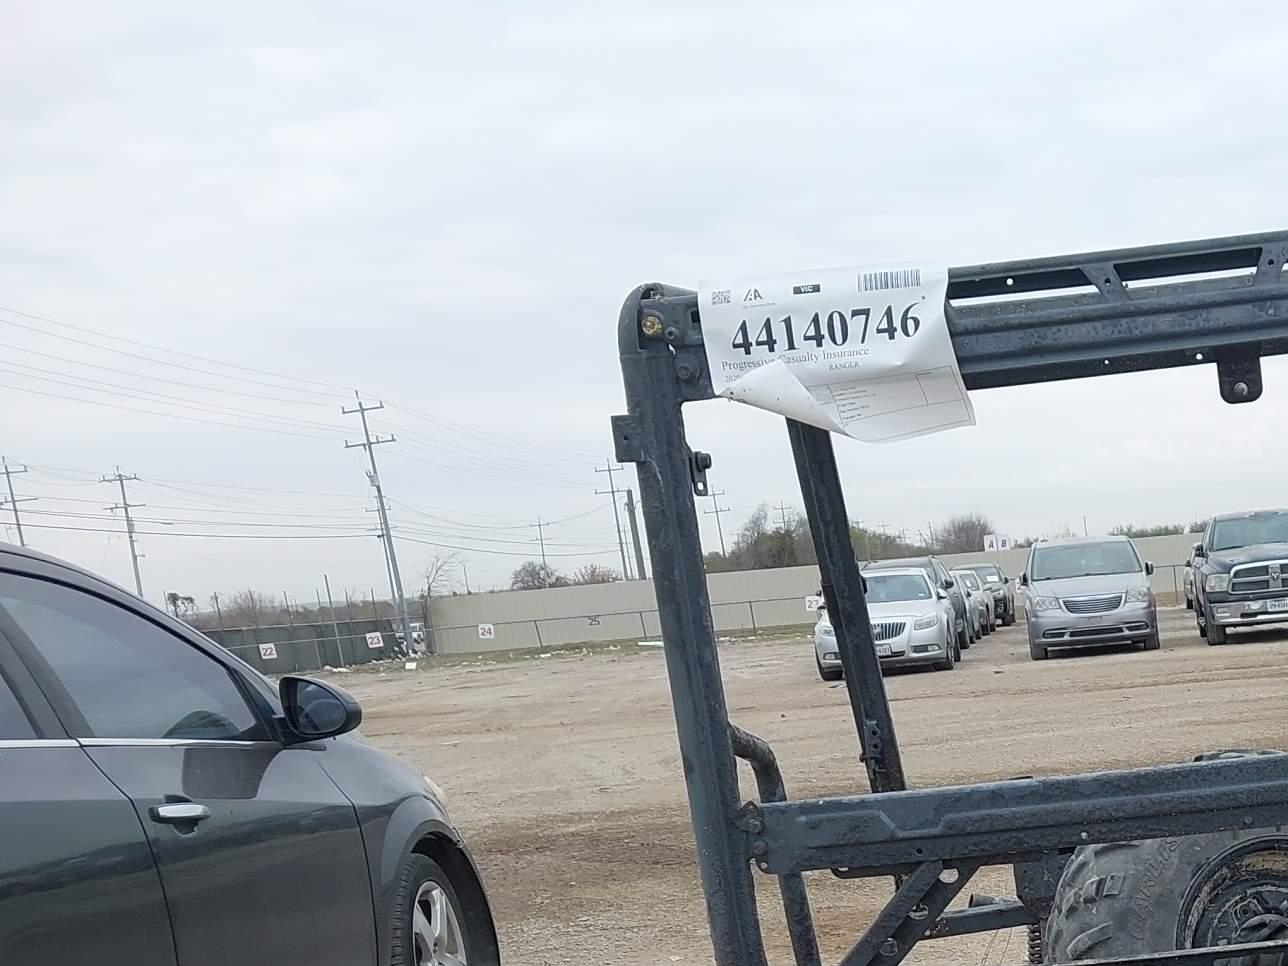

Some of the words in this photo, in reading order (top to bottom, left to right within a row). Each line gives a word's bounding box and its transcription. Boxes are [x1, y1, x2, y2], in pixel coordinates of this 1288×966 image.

[731, 301, 921, 356] 44140746
[823, 347, 869, 360] Insurance
[828, 361, 860, 371] RANGER
[588, 617, 600, 626] 25
[480, 627, 492, 636] 24
[367, 636, 381, 645] 23
[261, 647, 275, 656] 22
